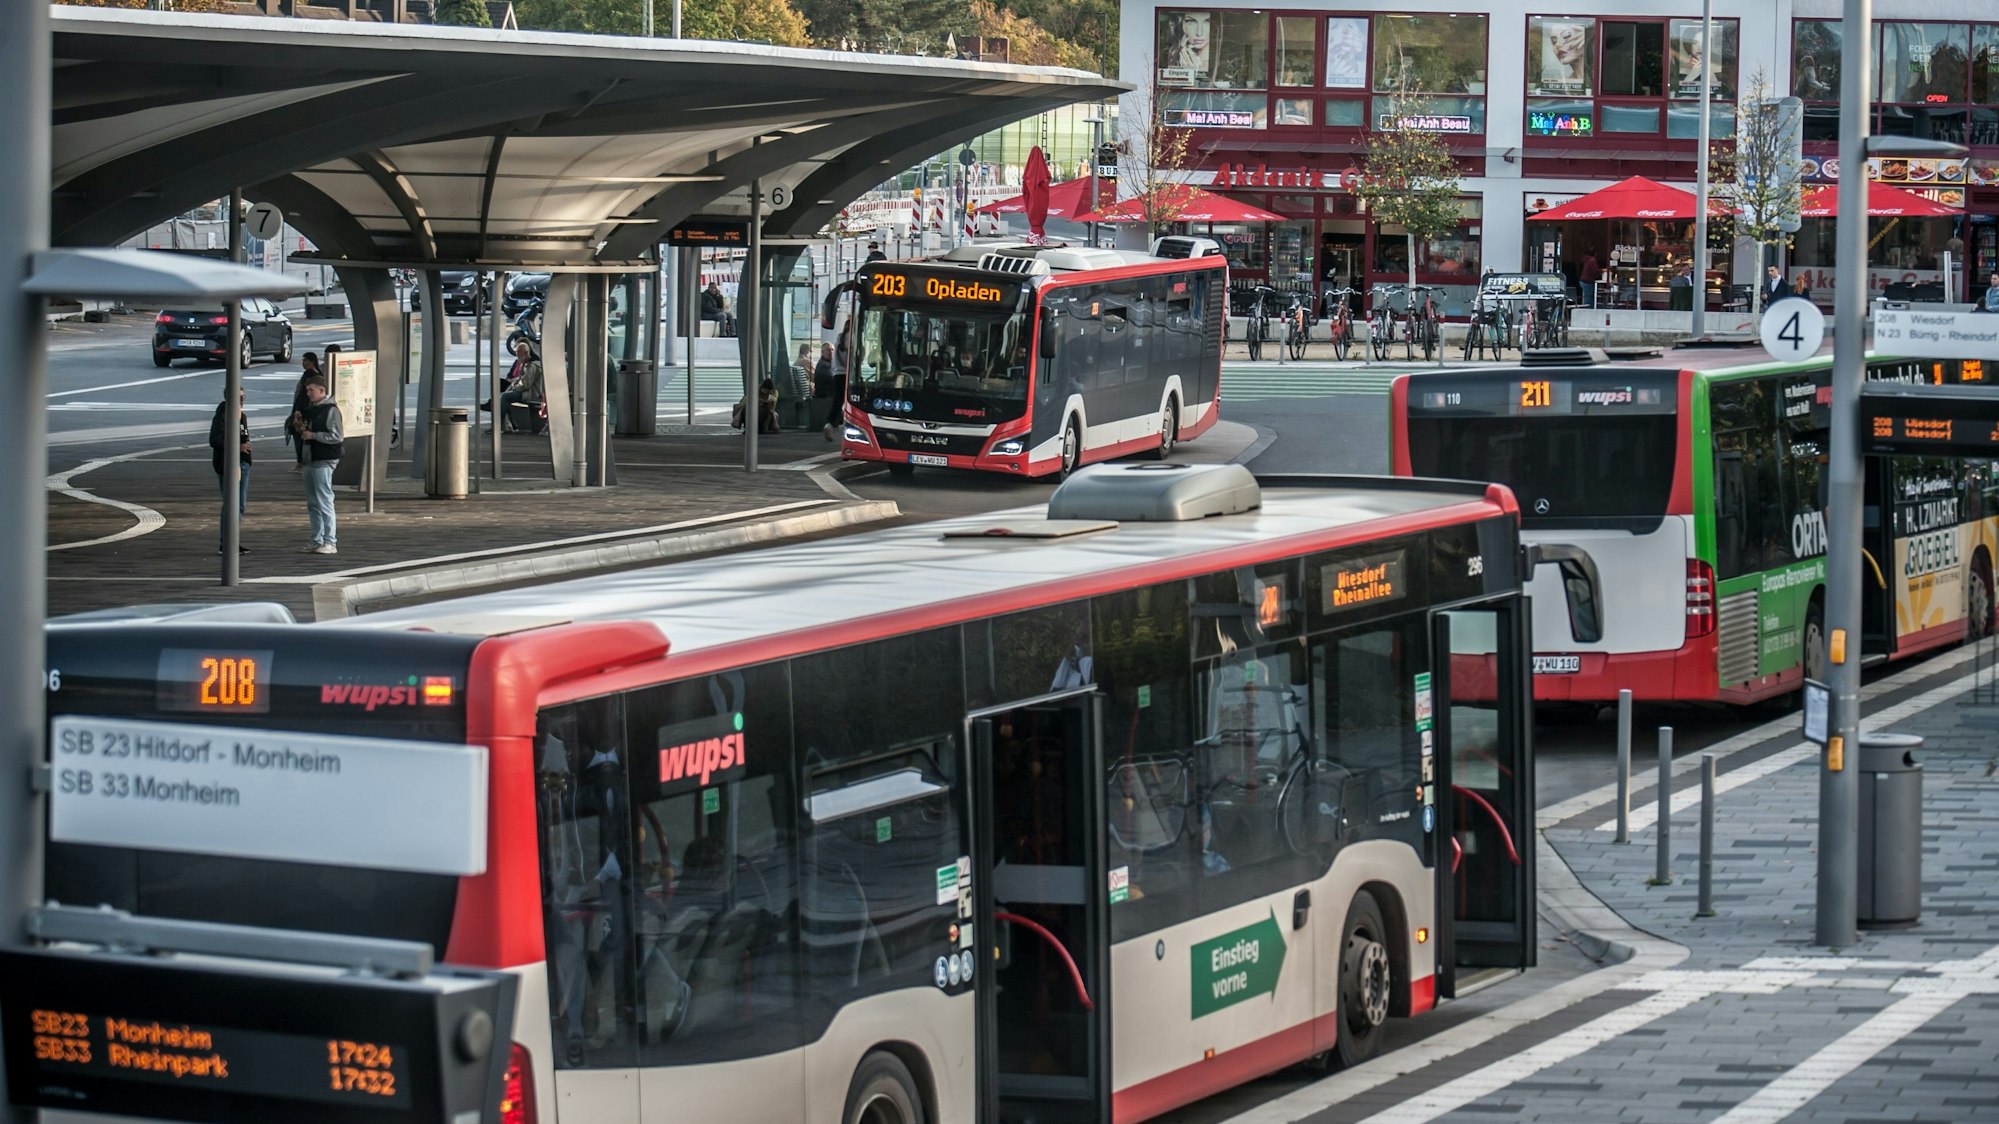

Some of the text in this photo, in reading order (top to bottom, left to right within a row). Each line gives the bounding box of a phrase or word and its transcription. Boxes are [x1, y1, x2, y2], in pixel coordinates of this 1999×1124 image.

[1206, 113, 1227, 124] Anh
[1419, 117, 1439, 129] Anh
[1442, 118, 1470, 129] Beau
[1531, 116, 1553, 129] Mai
[1555, 117, 1578, 129] Anh
[1212, 163, 1324, 190] Akdeniz
[772, 188, 784, 205] 6
[257, 209, 271, 232] 7
[1224, 233, 1255, 244] Grill
[873, 273, 1001, 302] 203 Opladen
[1487, 277, 1529, 286] FITNESS
[1777, 311, 1804, 350] 4
[1878, 314, 1956, 325] 208 Wiesdorf
[1877, 329, 1886, 338] N
[1888, 329, 1902, 339] 23
[1909, 329, 1940, 342] Bürrig
[1948, 330, 1998, 342] Rheindorf
[1447, 393, 1461, 405] 110
[1521, 381, 1550, 406] 211
[1578, 386, 1632, 406] wupsi
[954, 407, 986, 418] wupsi
[1873, 417, 1952, 430] 208 Wiesdorf
[911, 434, 949, 445] MAN
[1873, 427, 1893, 437] 208
[1905, 428, 1952, 440] Wiesdorf
[1337, 562, 1387, 588] Wiesdorf
[1467, 555, 1483, 576] 296
[1333, 581, 1392, 607] Rheinallee
[1560, 658, 1579, 669] 110
[200, 657, 255, 706] 208
[321, 675, 418, 712] wupsi
[61, 729, 95, 755] SB
[102, 733, 131, 758] 23
[134, 735, 212, 765] Hitdorf
[232, 742, 342, 774] Monheim
[660, 711, 745, 786] wupsi
[60, 769, 240, 806] SB 33 Monheim
[1211, 938, 1259, 972] Einstieg
[1212, 970, 1247, 999] vorne
[32, 1008, 393, 1069] SB23 Monheim 17:24
[34, 1035, 397, 1096] SB33 Rheinpark 17:32
